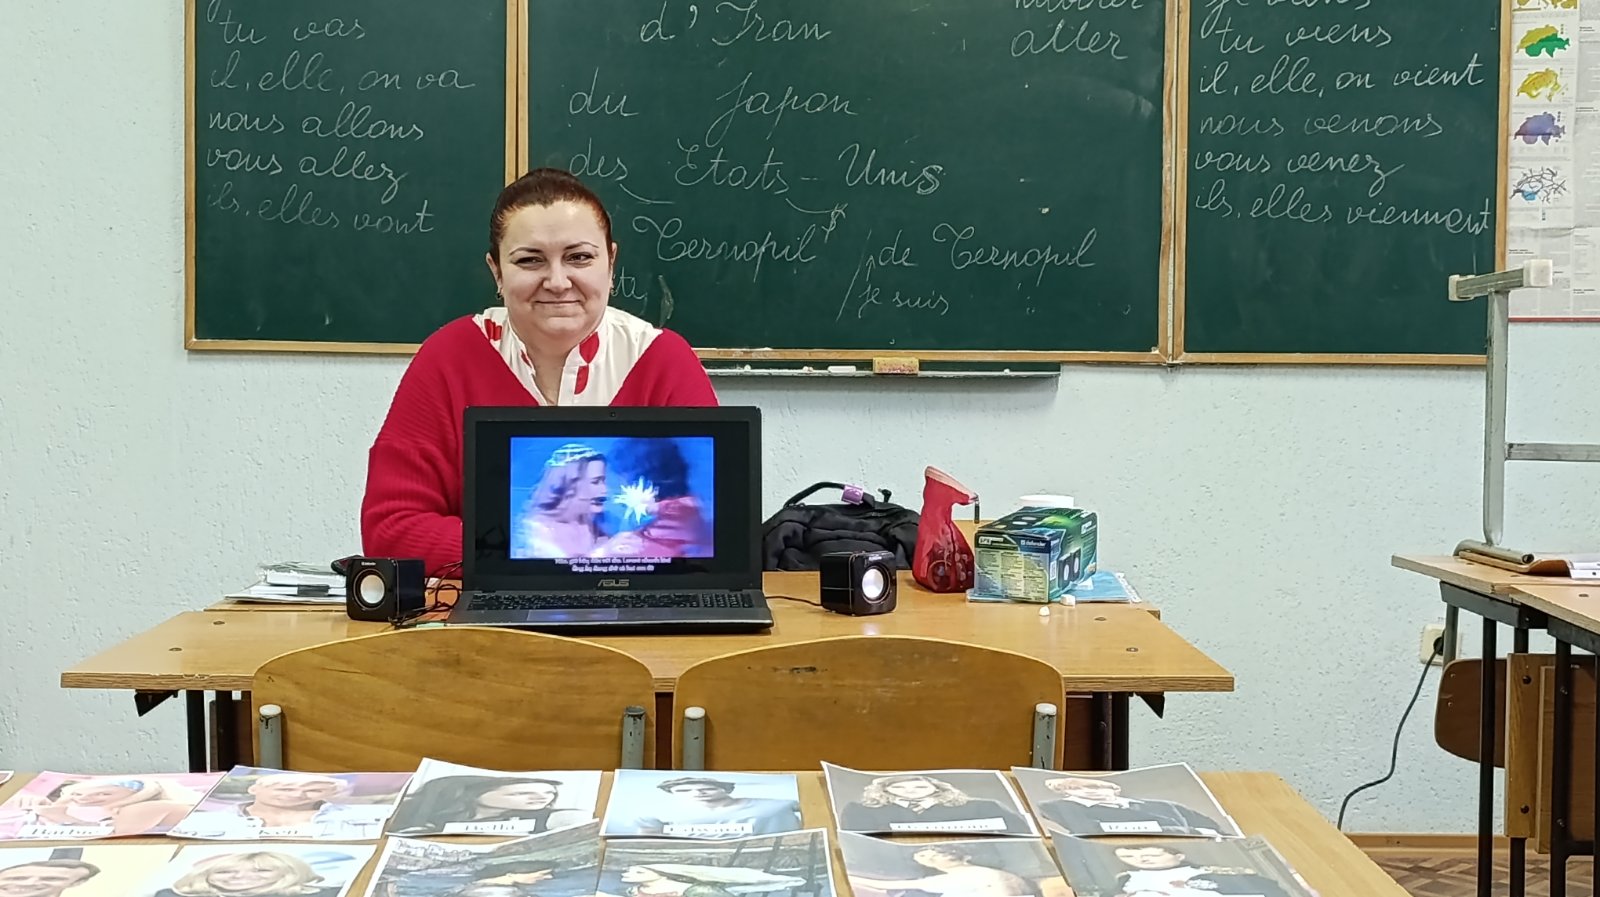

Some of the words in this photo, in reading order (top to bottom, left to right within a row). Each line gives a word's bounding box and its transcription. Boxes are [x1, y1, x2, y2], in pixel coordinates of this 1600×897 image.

[219, 9, 267, 44] tu
[293, 18, 366, 42] vas
[1010, 18, 1128, 59] aller
[1215, 17, 1265, 54] tu
[1286, 23, 1392, 48] viens
[258, 51, 344, 95] elle,
[358, 70, 401, 90] on
[416, 69, 476, 89] va
[1200, 61, 1238, 95] il,
[1250, 54, 1324, 98] elle,
[1336, 71, 1376, 90] on
[1393, 52, 1485, 87] vient
[208, 111, 285, 134] nous
[302, 101, 424, 140] allons
[569, 66, 639, 117] du
[705, 71, 858, 148] Japon
[1200, 114, 1285, 137] nous
[1304, 113, 1443, 138] venons
[206, 148, 283, 175] vous
[299, 146, 409, 204] allez
[569, 137, 628, 181] des
[1195, 151, 1271, 173] vous
[1287, 151, 1406, 198] venez
[258, 183, 340, 229] elles
[354, 199, 435, 234] vont
[1195, 178, 1241, 219] ils,
[1249, 183, 1333, 222] elles
[1346, 198, 1491, 236] viennent
[632, 215, 817, 283] Ternopil
[878, 229, 918, 267] de
[932, 222, 1097, 287] Ternopil
[892, 290, 949, 316] suis
[598, 579, 629, 587] ASUS
